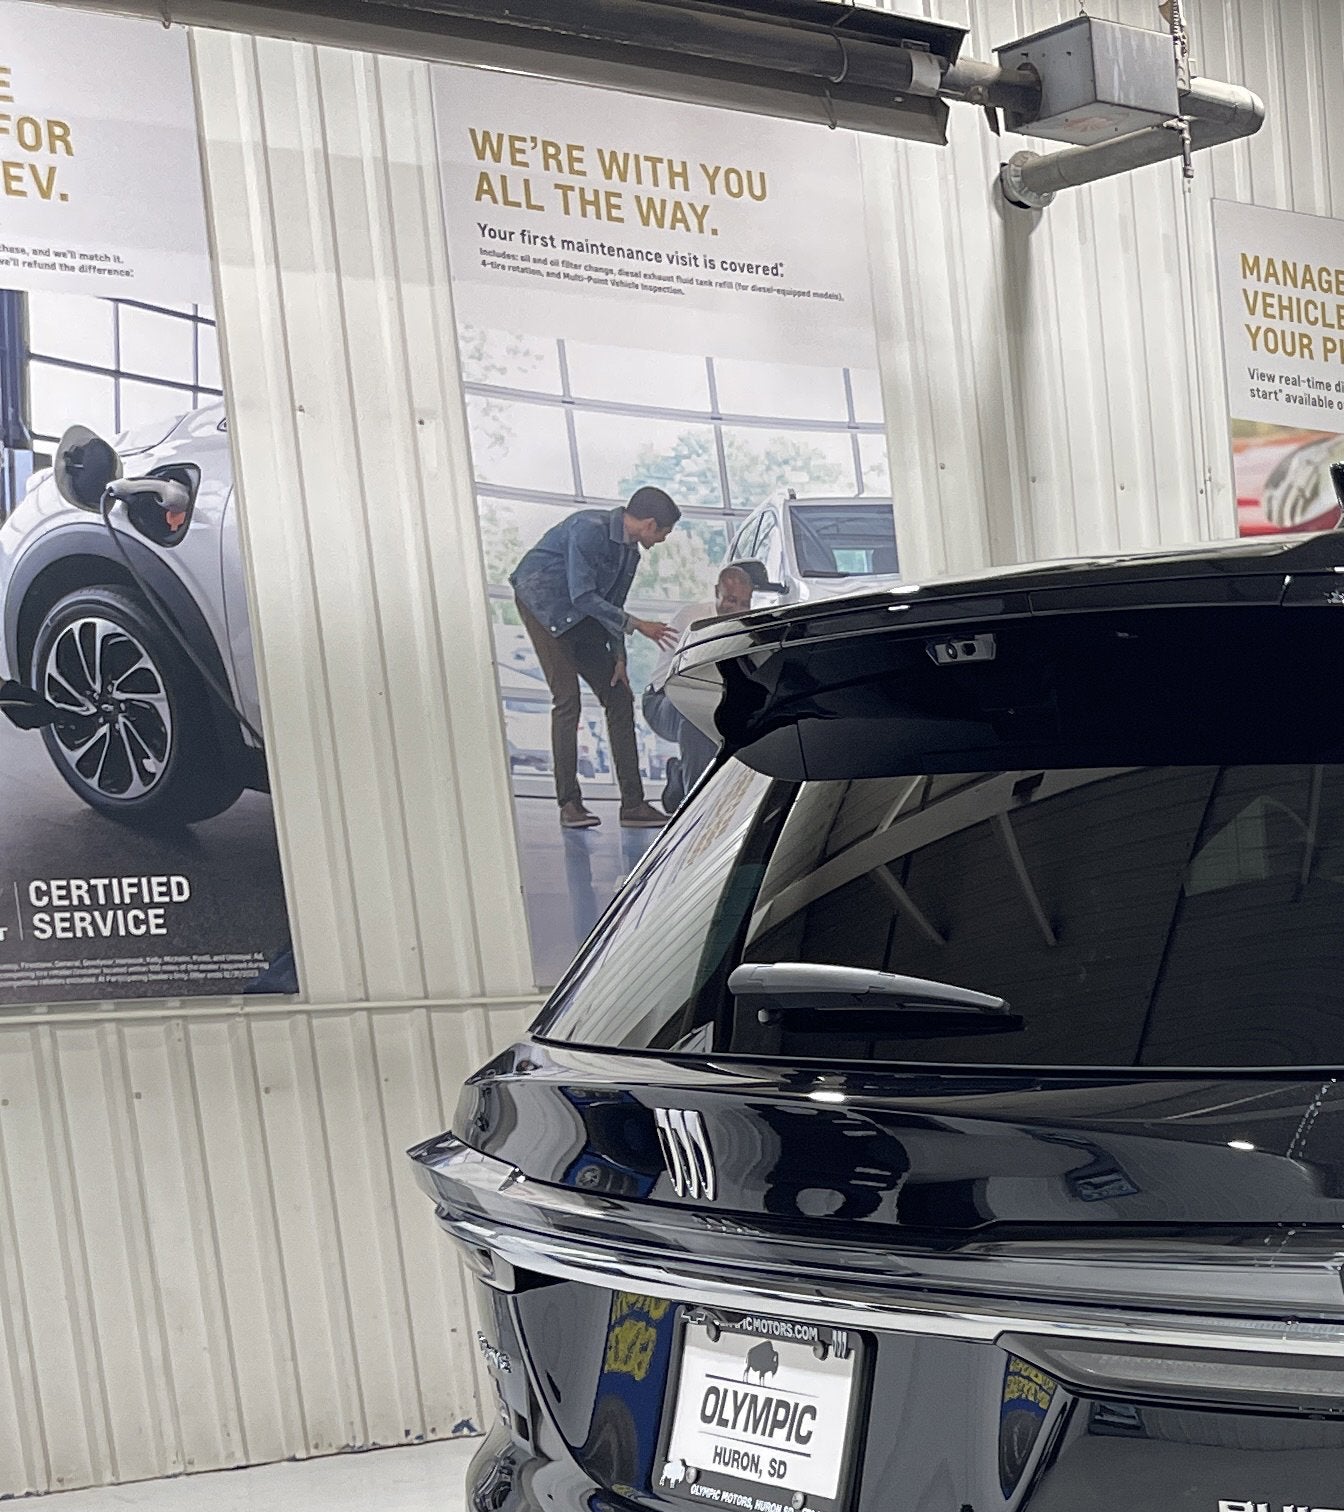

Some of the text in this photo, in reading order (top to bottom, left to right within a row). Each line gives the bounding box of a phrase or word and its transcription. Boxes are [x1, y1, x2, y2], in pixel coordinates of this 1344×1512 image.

[2, 160, 69, 201] EV.
[468, 128, 767, 202] WE'RE WITH YOU
[475, 171, 718, 236] ALL THE WAY.
[32, 248, 50, 257] and
[80, 253, 110, 262] match
[477, 222, 515, 241] Your
[520, 229, 556, 249] first
[561, 238, 662, 263] maintenance
[666, 250, 699, 268] visit
[703, 254, 716, 270] is
[23, 260, 56, 270] refund
[59, 263, 75, 272] the
[1245, 323, 1314, 360] YOUR
[1248, 367, 1275, 383] View
[1279, 375, 1331, 391] real-time
[1285, 393, 1334, 409] available
[28, 875, 190, 907] CERTIFIED
[32, 908, 167, 940] SERVICE
[699, 1385, 817, 1445] OLYMPIC
[712, 1445, 787, 1480] HURON, SD
[690, 1483, 721, 1501] OLYMPIC
[721, 1491, 753, 1510] MOTORS,
